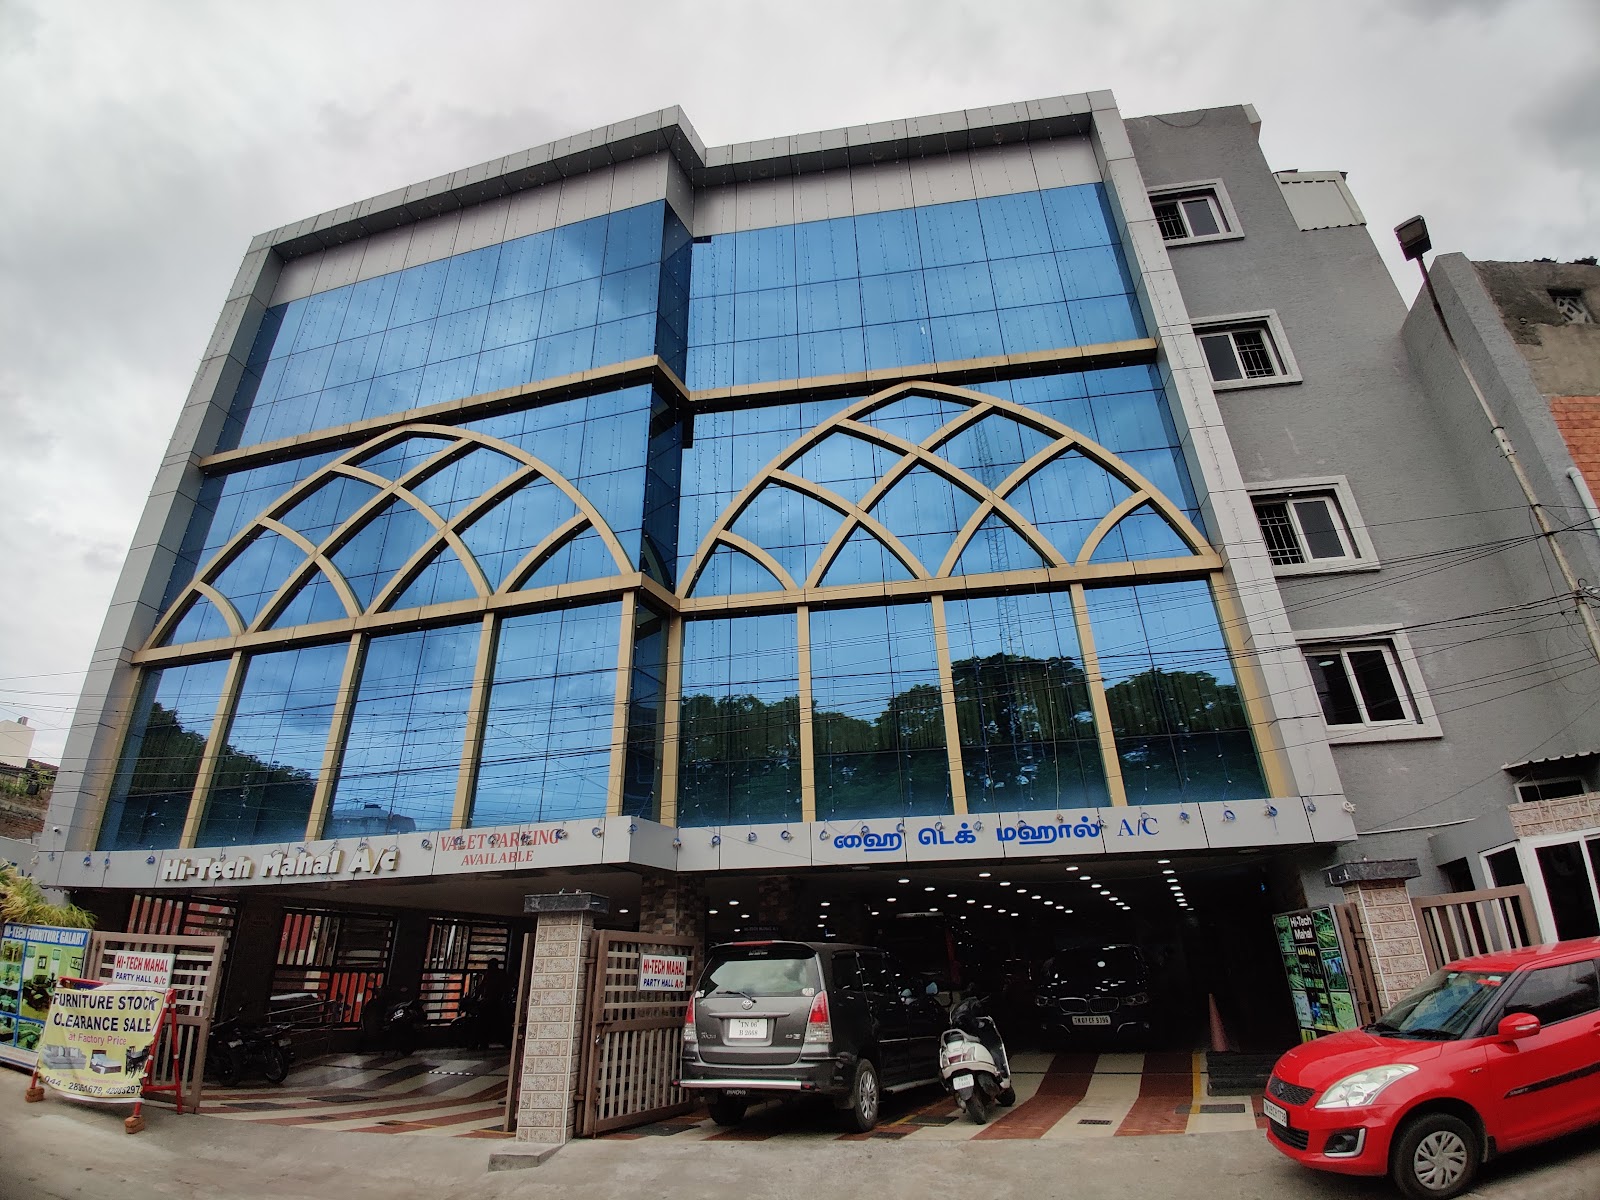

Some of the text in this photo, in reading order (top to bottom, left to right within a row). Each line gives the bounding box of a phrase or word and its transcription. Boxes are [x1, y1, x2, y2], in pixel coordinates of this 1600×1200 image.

[834, 816, 1100, 852] ஹை டெக் மஹால்
[1117, 818, 1160, 837] A/C
[161, 855, 255, 881] Hi-Tech
[260, 849, 345, 877] Mahal
[461, 851, 534, 866] AVAILABLE
[116, 955, 168, 972] HI-TECH MAHAL
[643, 959, 685, 975] HI-TECH MAHAL
[115, 971, 134, 980] PARTY
[135, 974, 152, 983] HALL
[643, 978, 661, 987] PARTY
[661, 979, 674, 987] HALL
[53, 993, 159, 1011] FURNITURE STOCK
[53, 1012, 151, 1033] CLEARANCE SALE
[68, 1032, 127, 1046] at Factory Price
